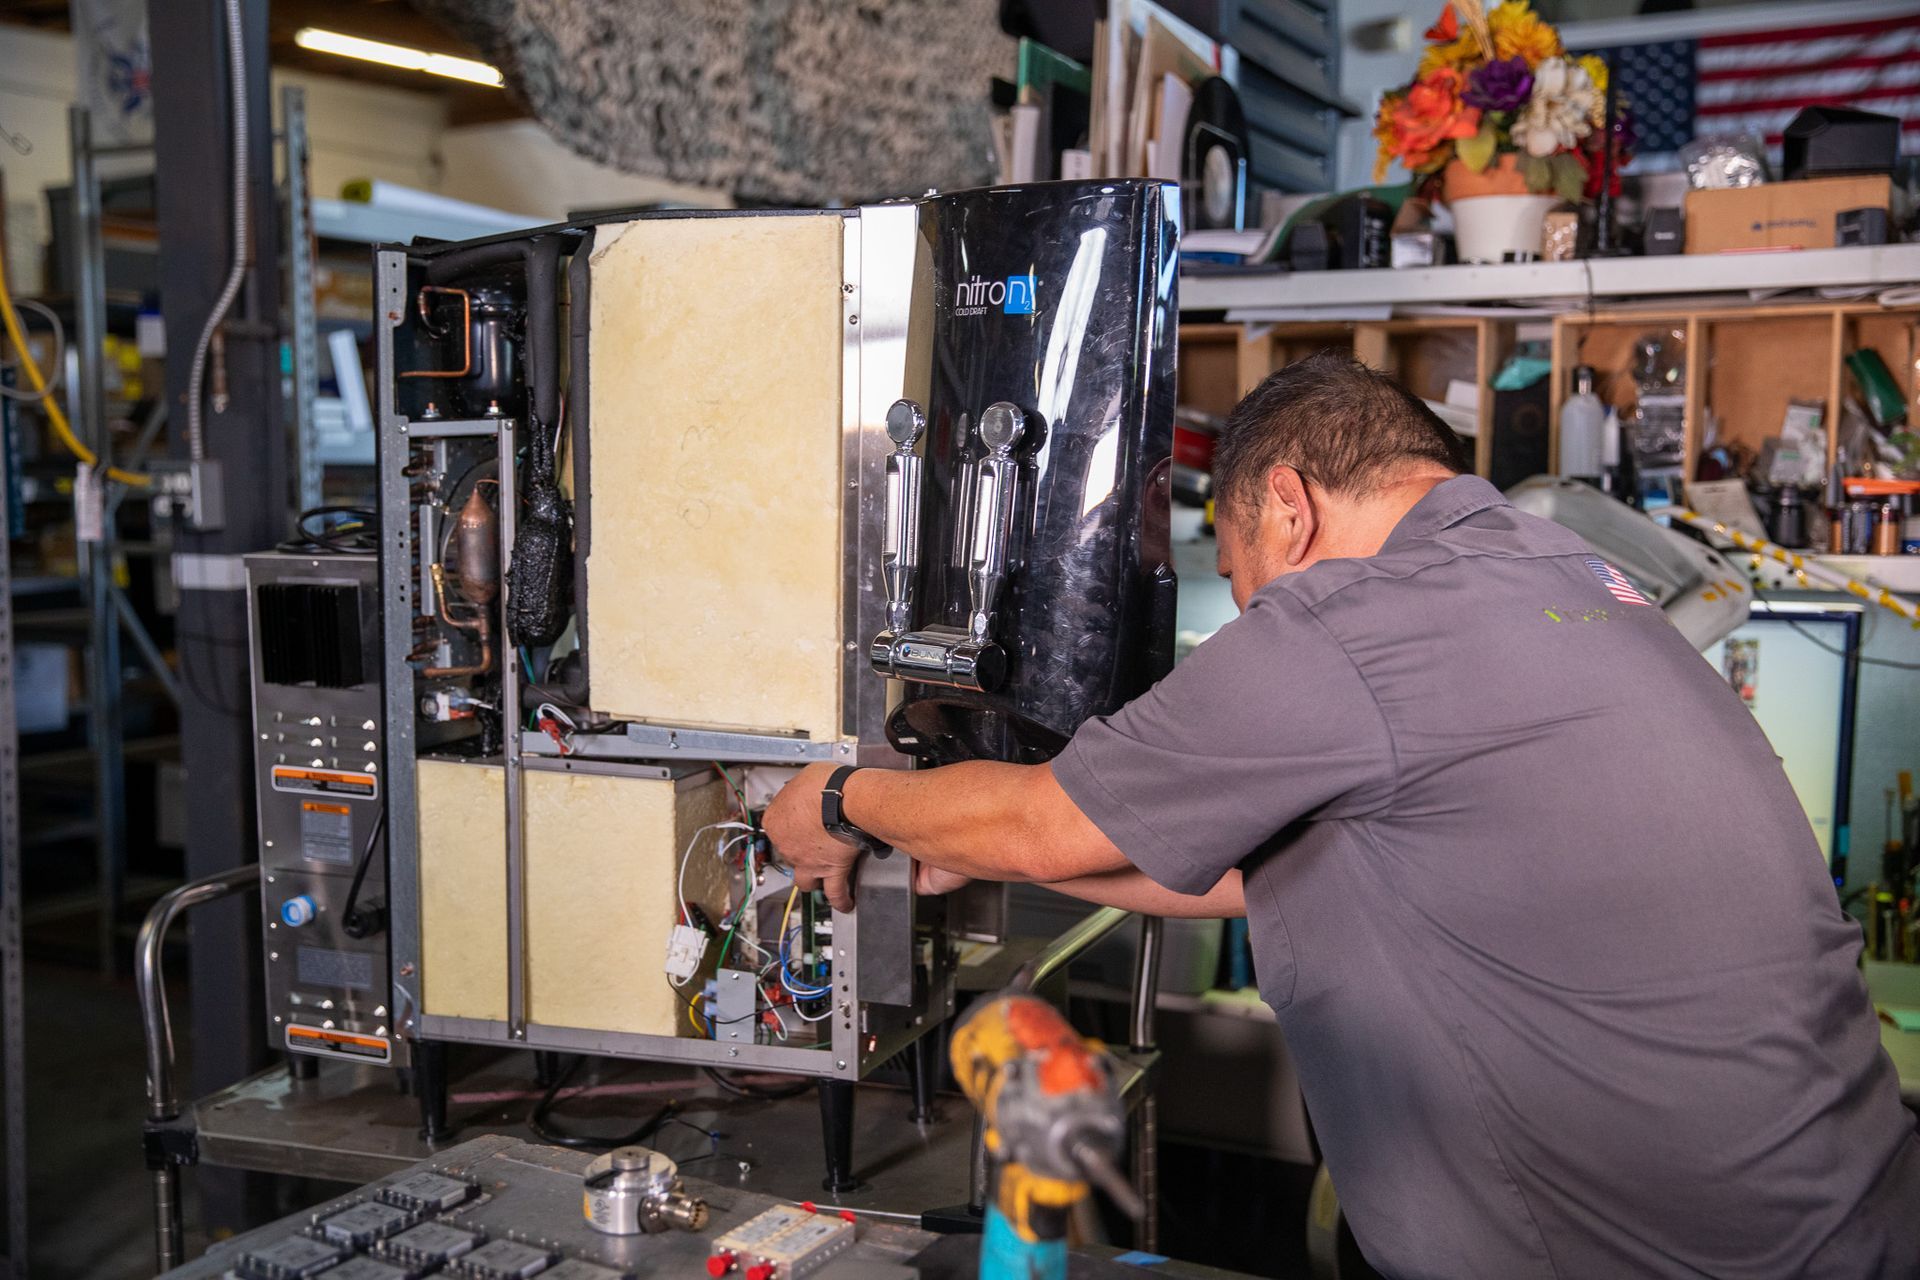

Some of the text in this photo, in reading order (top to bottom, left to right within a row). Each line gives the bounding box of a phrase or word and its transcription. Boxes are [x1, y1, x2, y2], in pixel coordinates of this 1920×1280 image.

[955, 307, 988, 316] COLD DRAFT
[911, 649, 943, 660] BUNN
